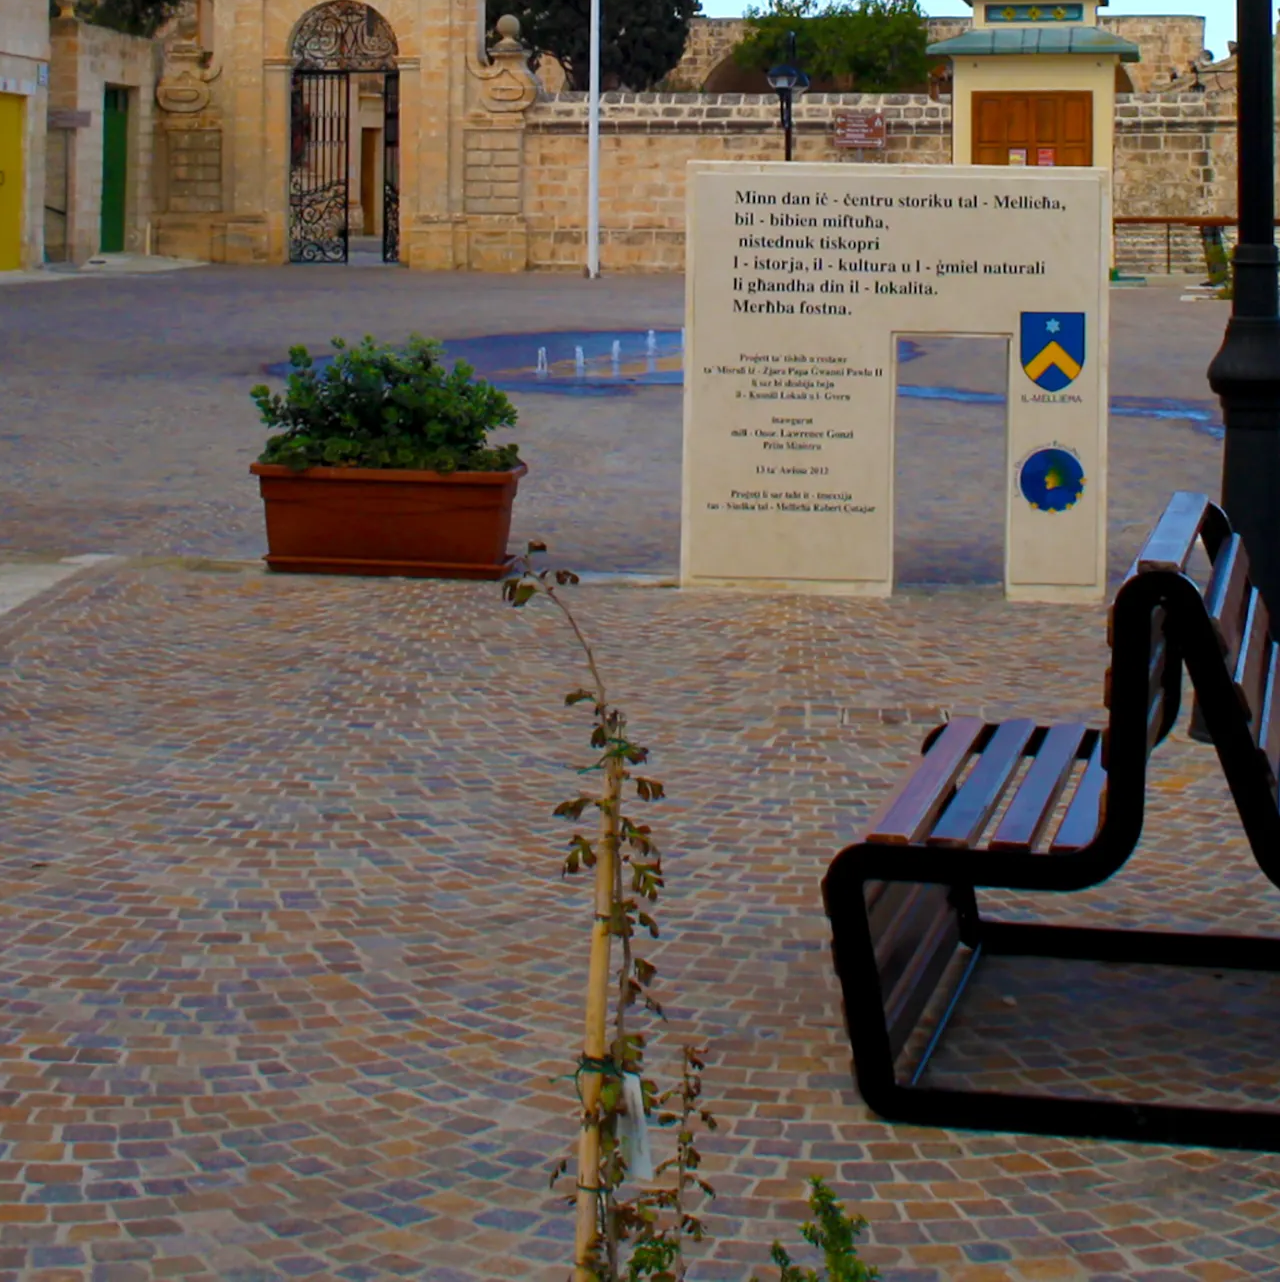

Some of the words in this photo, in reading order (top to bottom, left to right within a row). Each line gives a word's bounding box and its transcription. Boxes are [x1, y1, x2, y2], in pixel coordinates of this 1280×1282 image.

[736, 190, 776, 206] Minn
[782, 192, 810, 206] dan
[843, 193, 893, 207] ċentru
[898, 194, 953, 208] storiku
[958, 195, 978, 208] tal
[994, 195, 1066, 211] Mellieħa,
[735, 212, 754, 226] bil
[770, 213, 817, 227] bibien
[823, 215, 889, 230] miftuħa,
[739, 234, 815, 249] nistednuk
[820, 236, 880, 253] tiskopri
[754, 256, 809, 273] istorja,
[813, 258, 823, 270] il
[838, 258, 897, 272] kultura
[901, 263, 910, 273] u
[936, 260, 978, 276] ġmiel
[983, 261, 1045, 275] naturali
[733, 278, 742, 290] li
[748, 278, 815, 294] għandha
[820, 280, 844, 293] din
[850, 280, 859, 293] il
[733, 299, 794, 314] Merħba
[799, 301, 852, 315] fostna.
[788, 368, 808, 376] Papa
[846, 368, 872, 376] Pawlu
[875, 368, 882, 376] II
[824, 393, 850, 401] Gvern
[780, 430, 823, 439] Lawrence
[826, 431, 854, 439] Gonzi
[786, 442, 821, 450] Ministru
[813, 505, 841, 513] Robert
